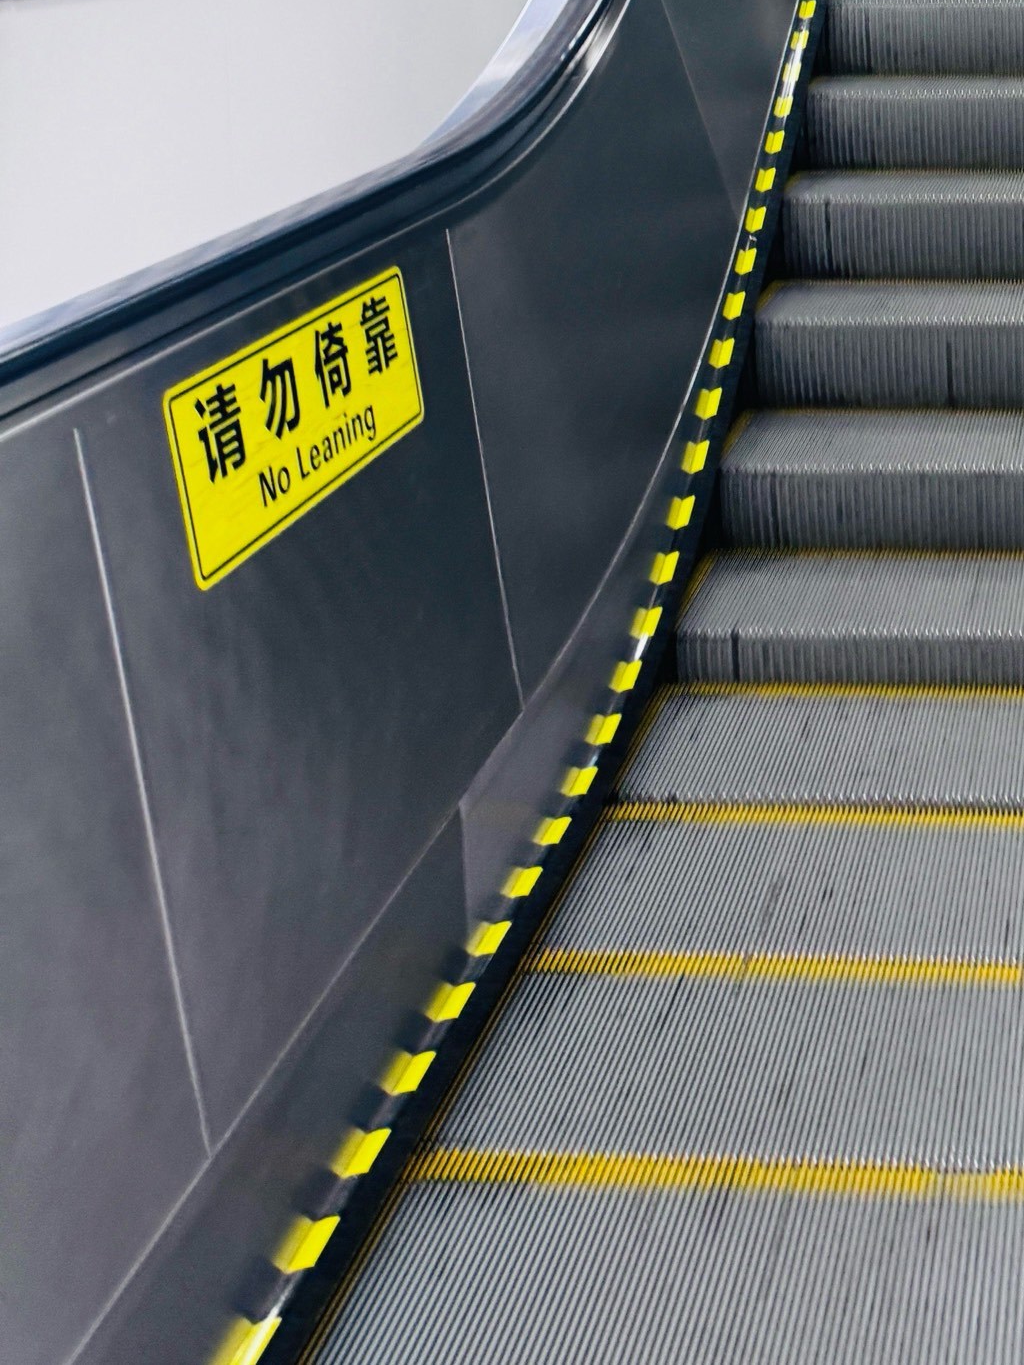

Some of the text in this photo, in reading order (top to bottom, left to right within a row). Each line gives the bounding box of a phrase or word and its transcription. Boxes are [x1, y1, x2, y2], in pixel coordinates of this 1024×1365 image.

[194, 296, 398, 483] 请勿倚靠
[258, 404, 377, 507] No Leaning
